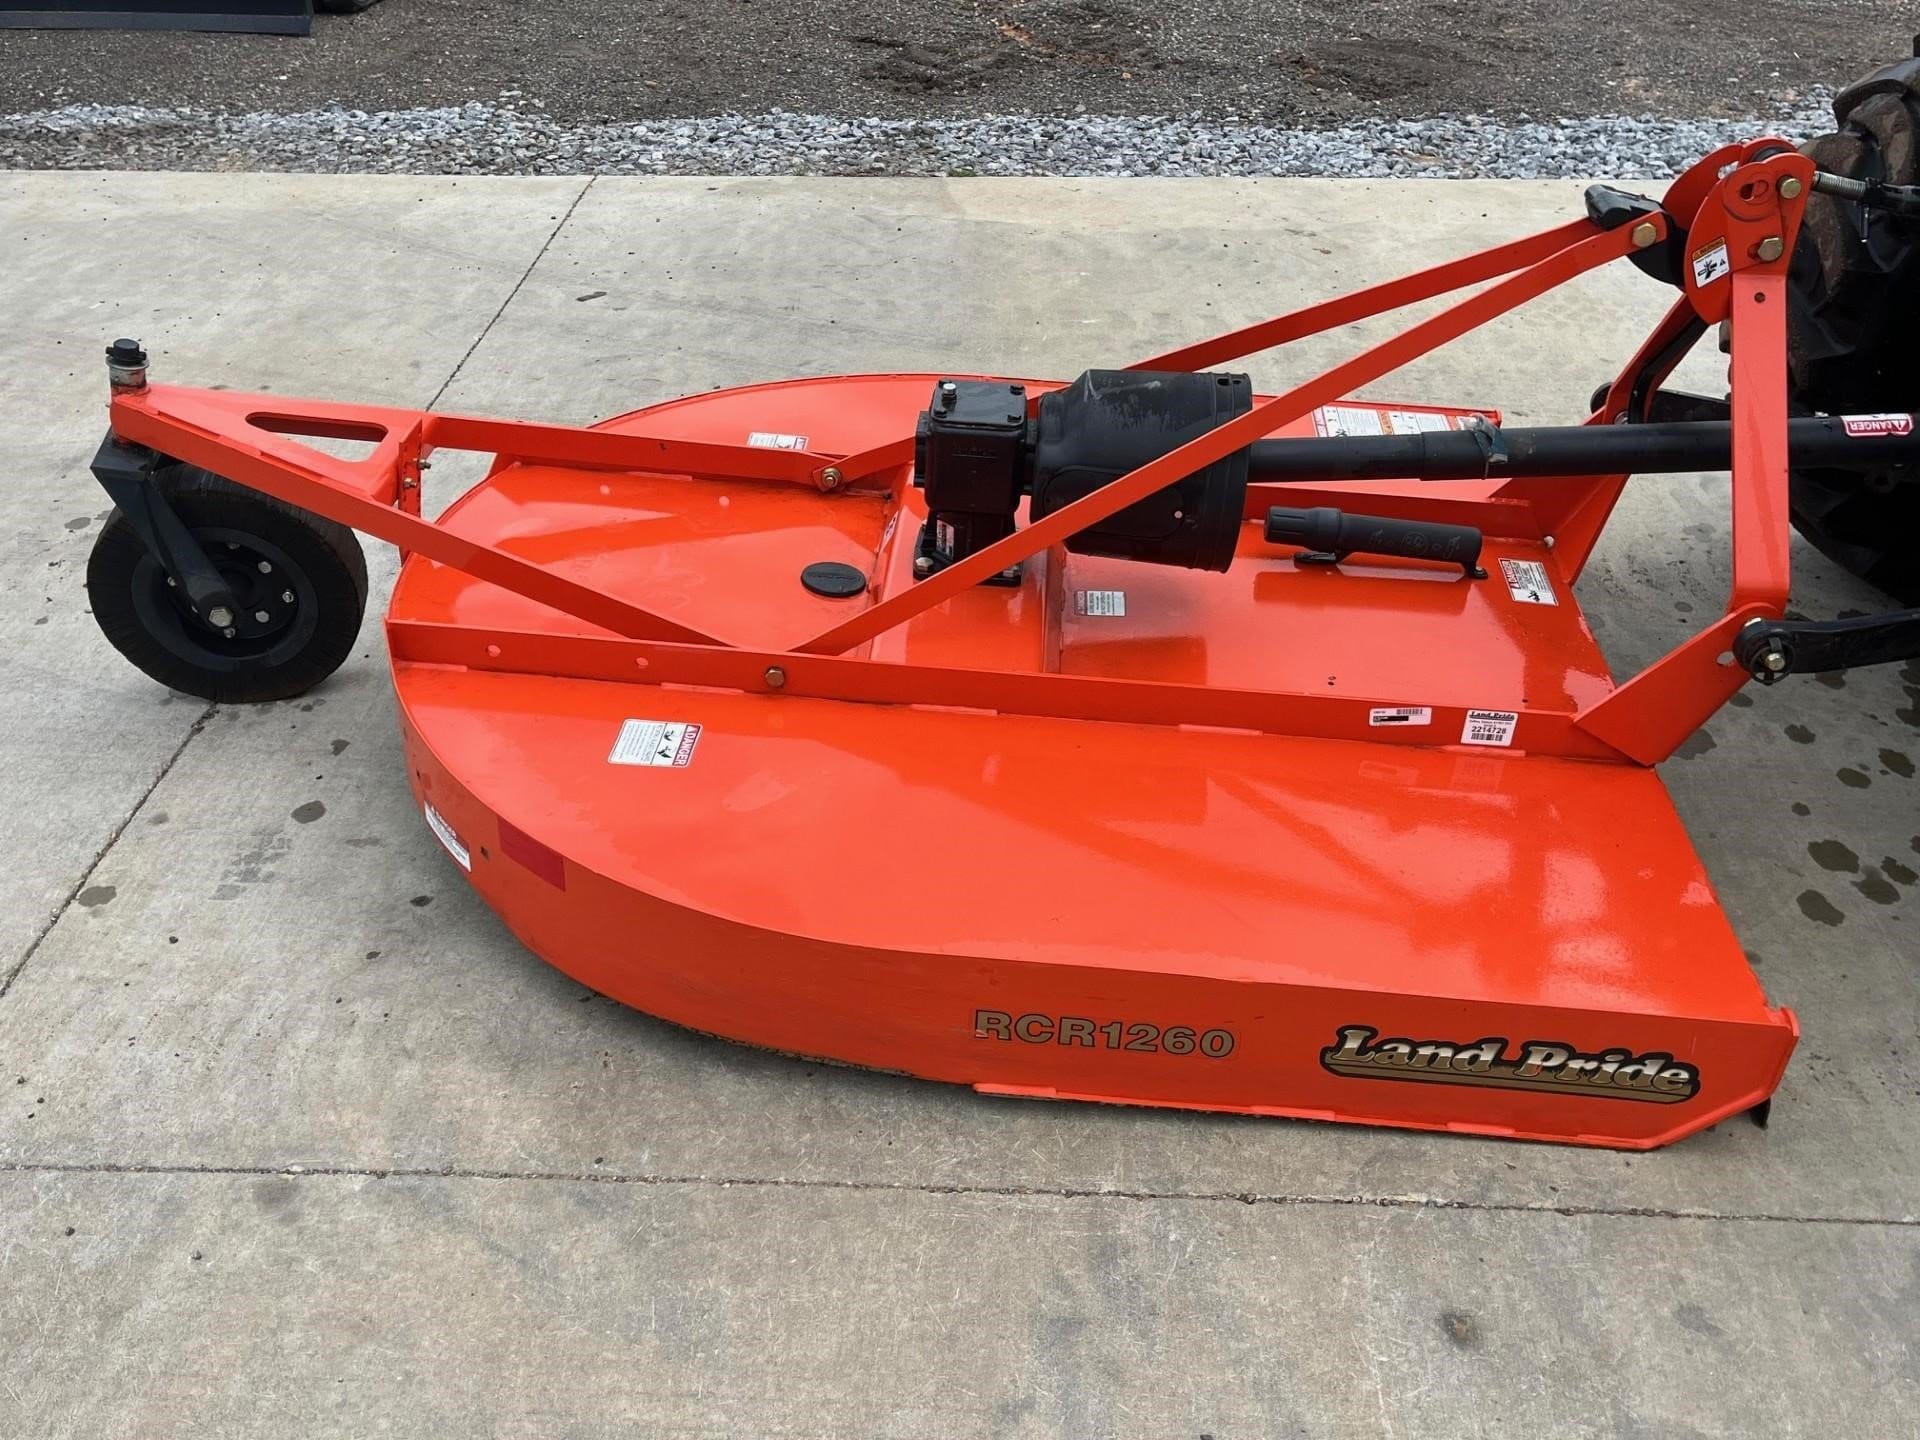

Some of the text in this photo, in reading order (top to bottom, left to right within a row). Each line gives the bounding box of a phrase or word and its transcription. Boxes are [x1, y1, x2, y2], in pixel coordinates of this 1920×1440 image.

[1849, 421, 1893, 431] DANGER
[1470, 711, 1515, 721] Land Pride
[1471, 725, 1507, 735] 2214728
[674, 732, 696, 765] DANGER
[974, 1009, 1235, 1058] RCR1260
[1331, 1027, 1692, 1091] Land Pride
